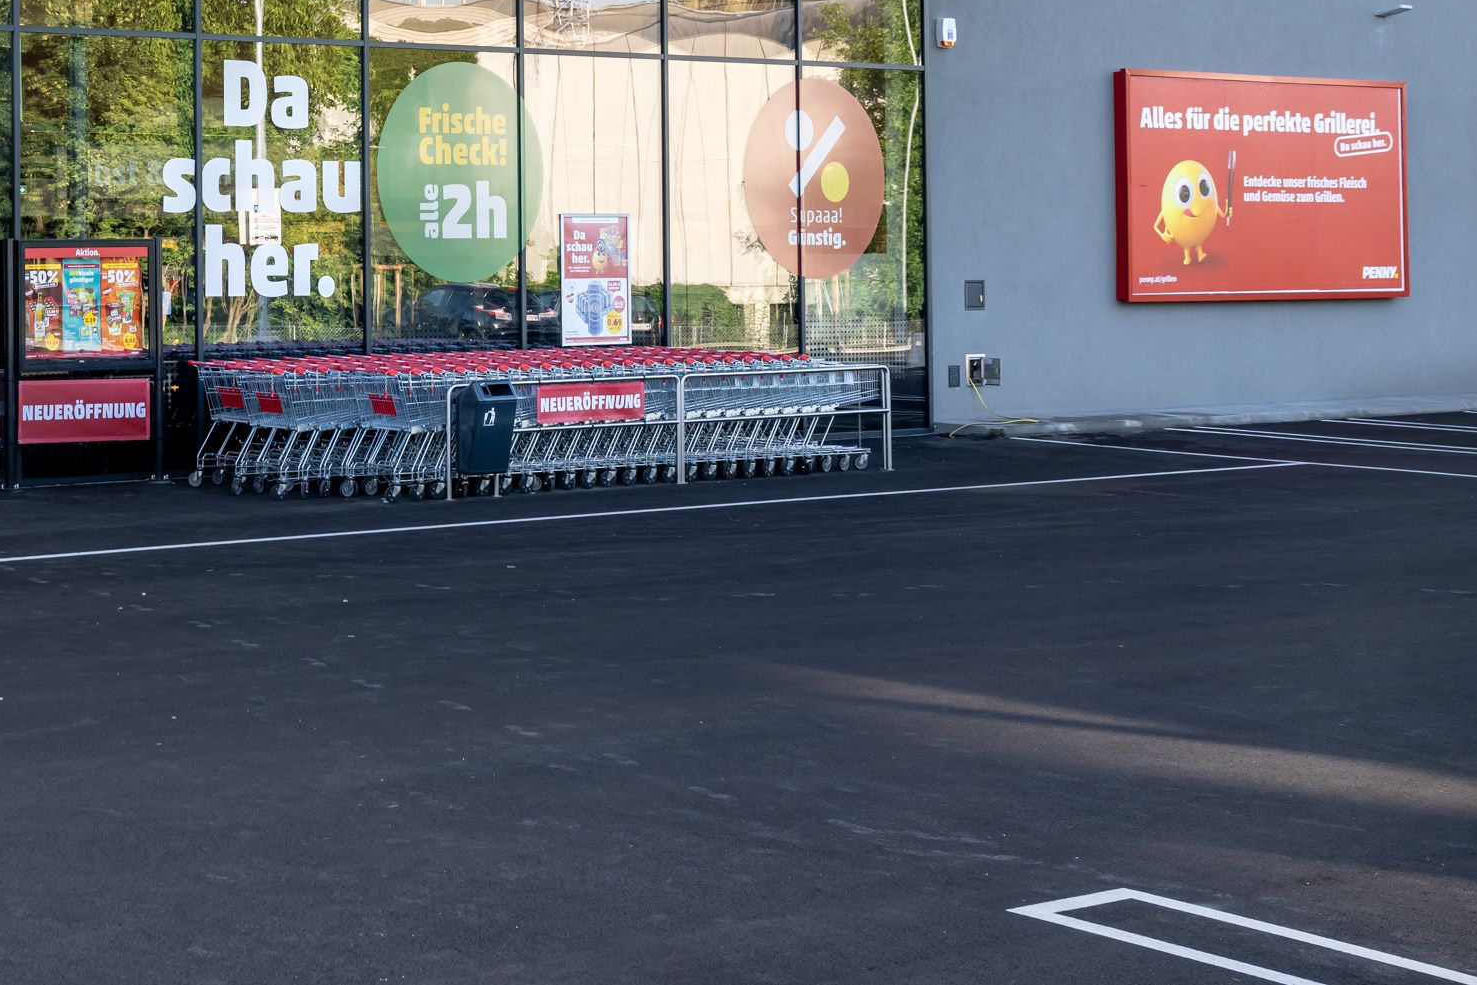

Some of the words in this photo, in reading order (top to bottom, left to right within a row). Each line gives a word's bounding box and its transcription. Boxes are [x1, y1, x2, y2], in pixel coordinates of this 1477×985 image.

[224, 59, 309, 129] Da
[418, 103, 507, 135] Frische
[1140, 106, 1183, 130] Alles
[1186, 107, 1210, 130] für
[1213, 108, 1240, 131] die
[1242, 111, 1311, 136] perfekte
[1314, 110, 1381, 135] Grillerei.
[418, 135, 508, 166] Check!
[1339, 142, 1350, 152] Da
[1351, 139, 1372, 150] schau
[162, 140, 361, 213] schau
[1243, 175, 1281, 188] Entdecke
[1283, 177, 1306, 188] unser
[1307, 175, 1338, 189] frisches
[1339, 176, 1367, 189] Fleisch
[1243, 190, 1260, 202] und
[1262, 190, 1295, 202] Gemüse
[1296, 192, 1314, 202] zum
[1315, 191, 1345, 203] Grillen.
[420, 184, 439, 239] alle
[442, 181, 508, 239] 2h
[790, 207, 843, 226] Supaaa!
[573, 229, 586, 240] Da
[787, 227, 847, 250] Günstig.
[75, 248, 101, 256] Aktion.
[566, 241, 593, 252] schau
[205, 224, 336, 297] her.
[571, 253, 590, 264] her.
[1362, 266, 1399, 279] PENNY.
[22, 399, 147, 422] NEUERÖFFNUNG
[540, 391, 641, 413] NEUERÖFFNUNG
